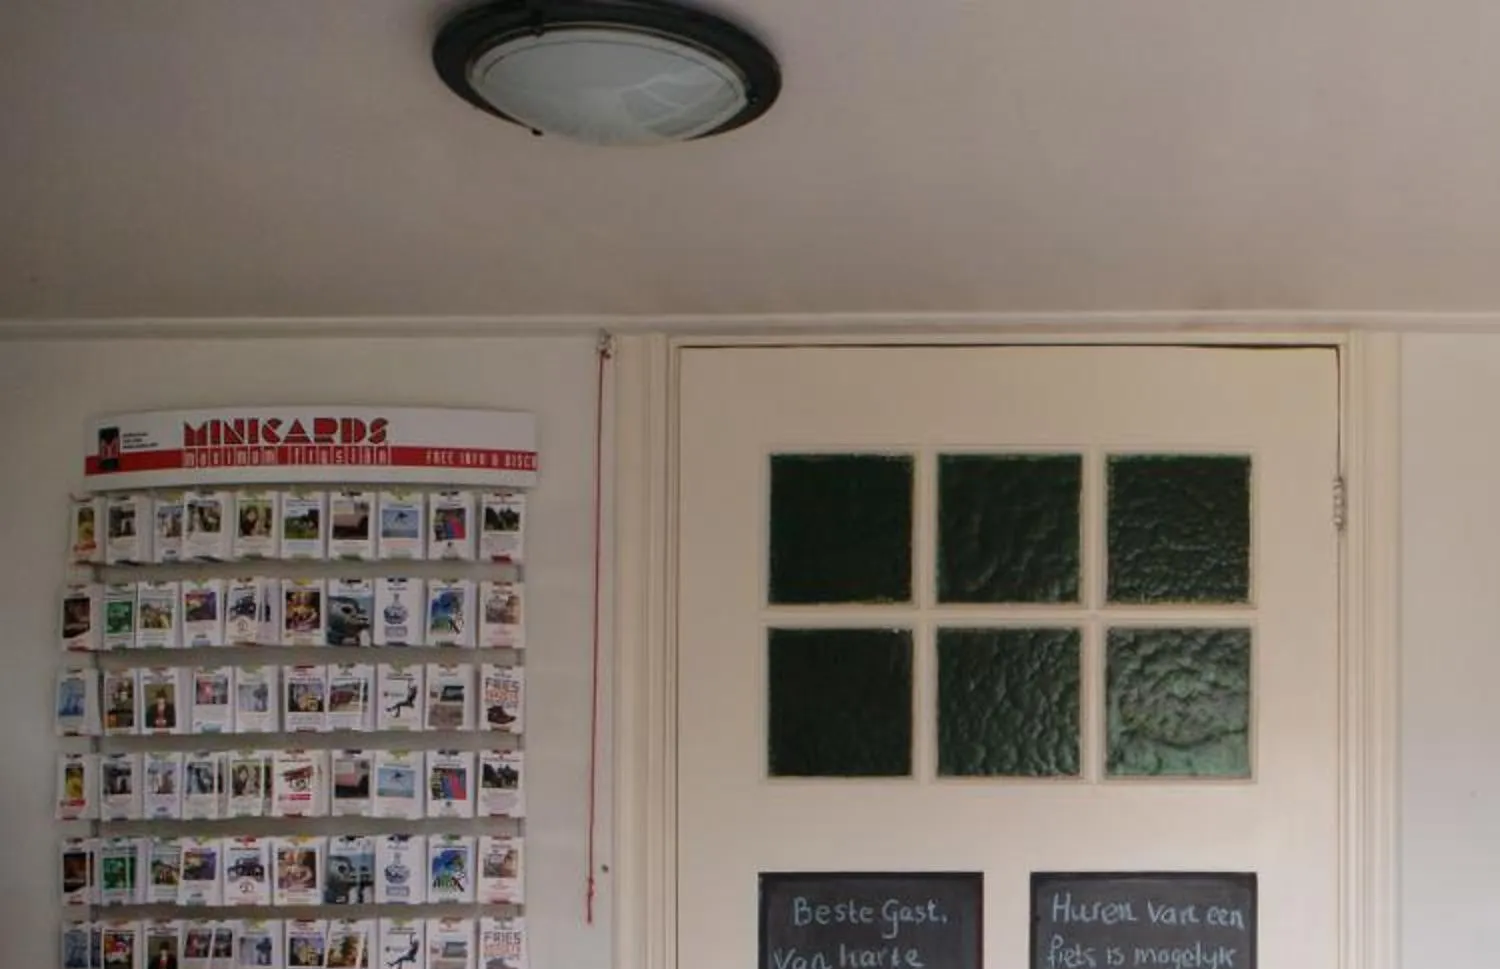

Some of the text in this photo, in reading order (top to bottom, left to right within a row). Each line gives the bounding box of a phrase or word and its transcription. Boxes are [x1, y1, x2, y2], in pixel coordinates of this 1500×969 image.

[184, 417, 390, 447] MINICARDS
[794, 896, 874, 926] Beste
[1052, 892, 1138, 925] Huren
[1206, 906, 1245, 930] een
[840, 943, 925, 969] harte
[1048, 933, 1097, 968] fiets
